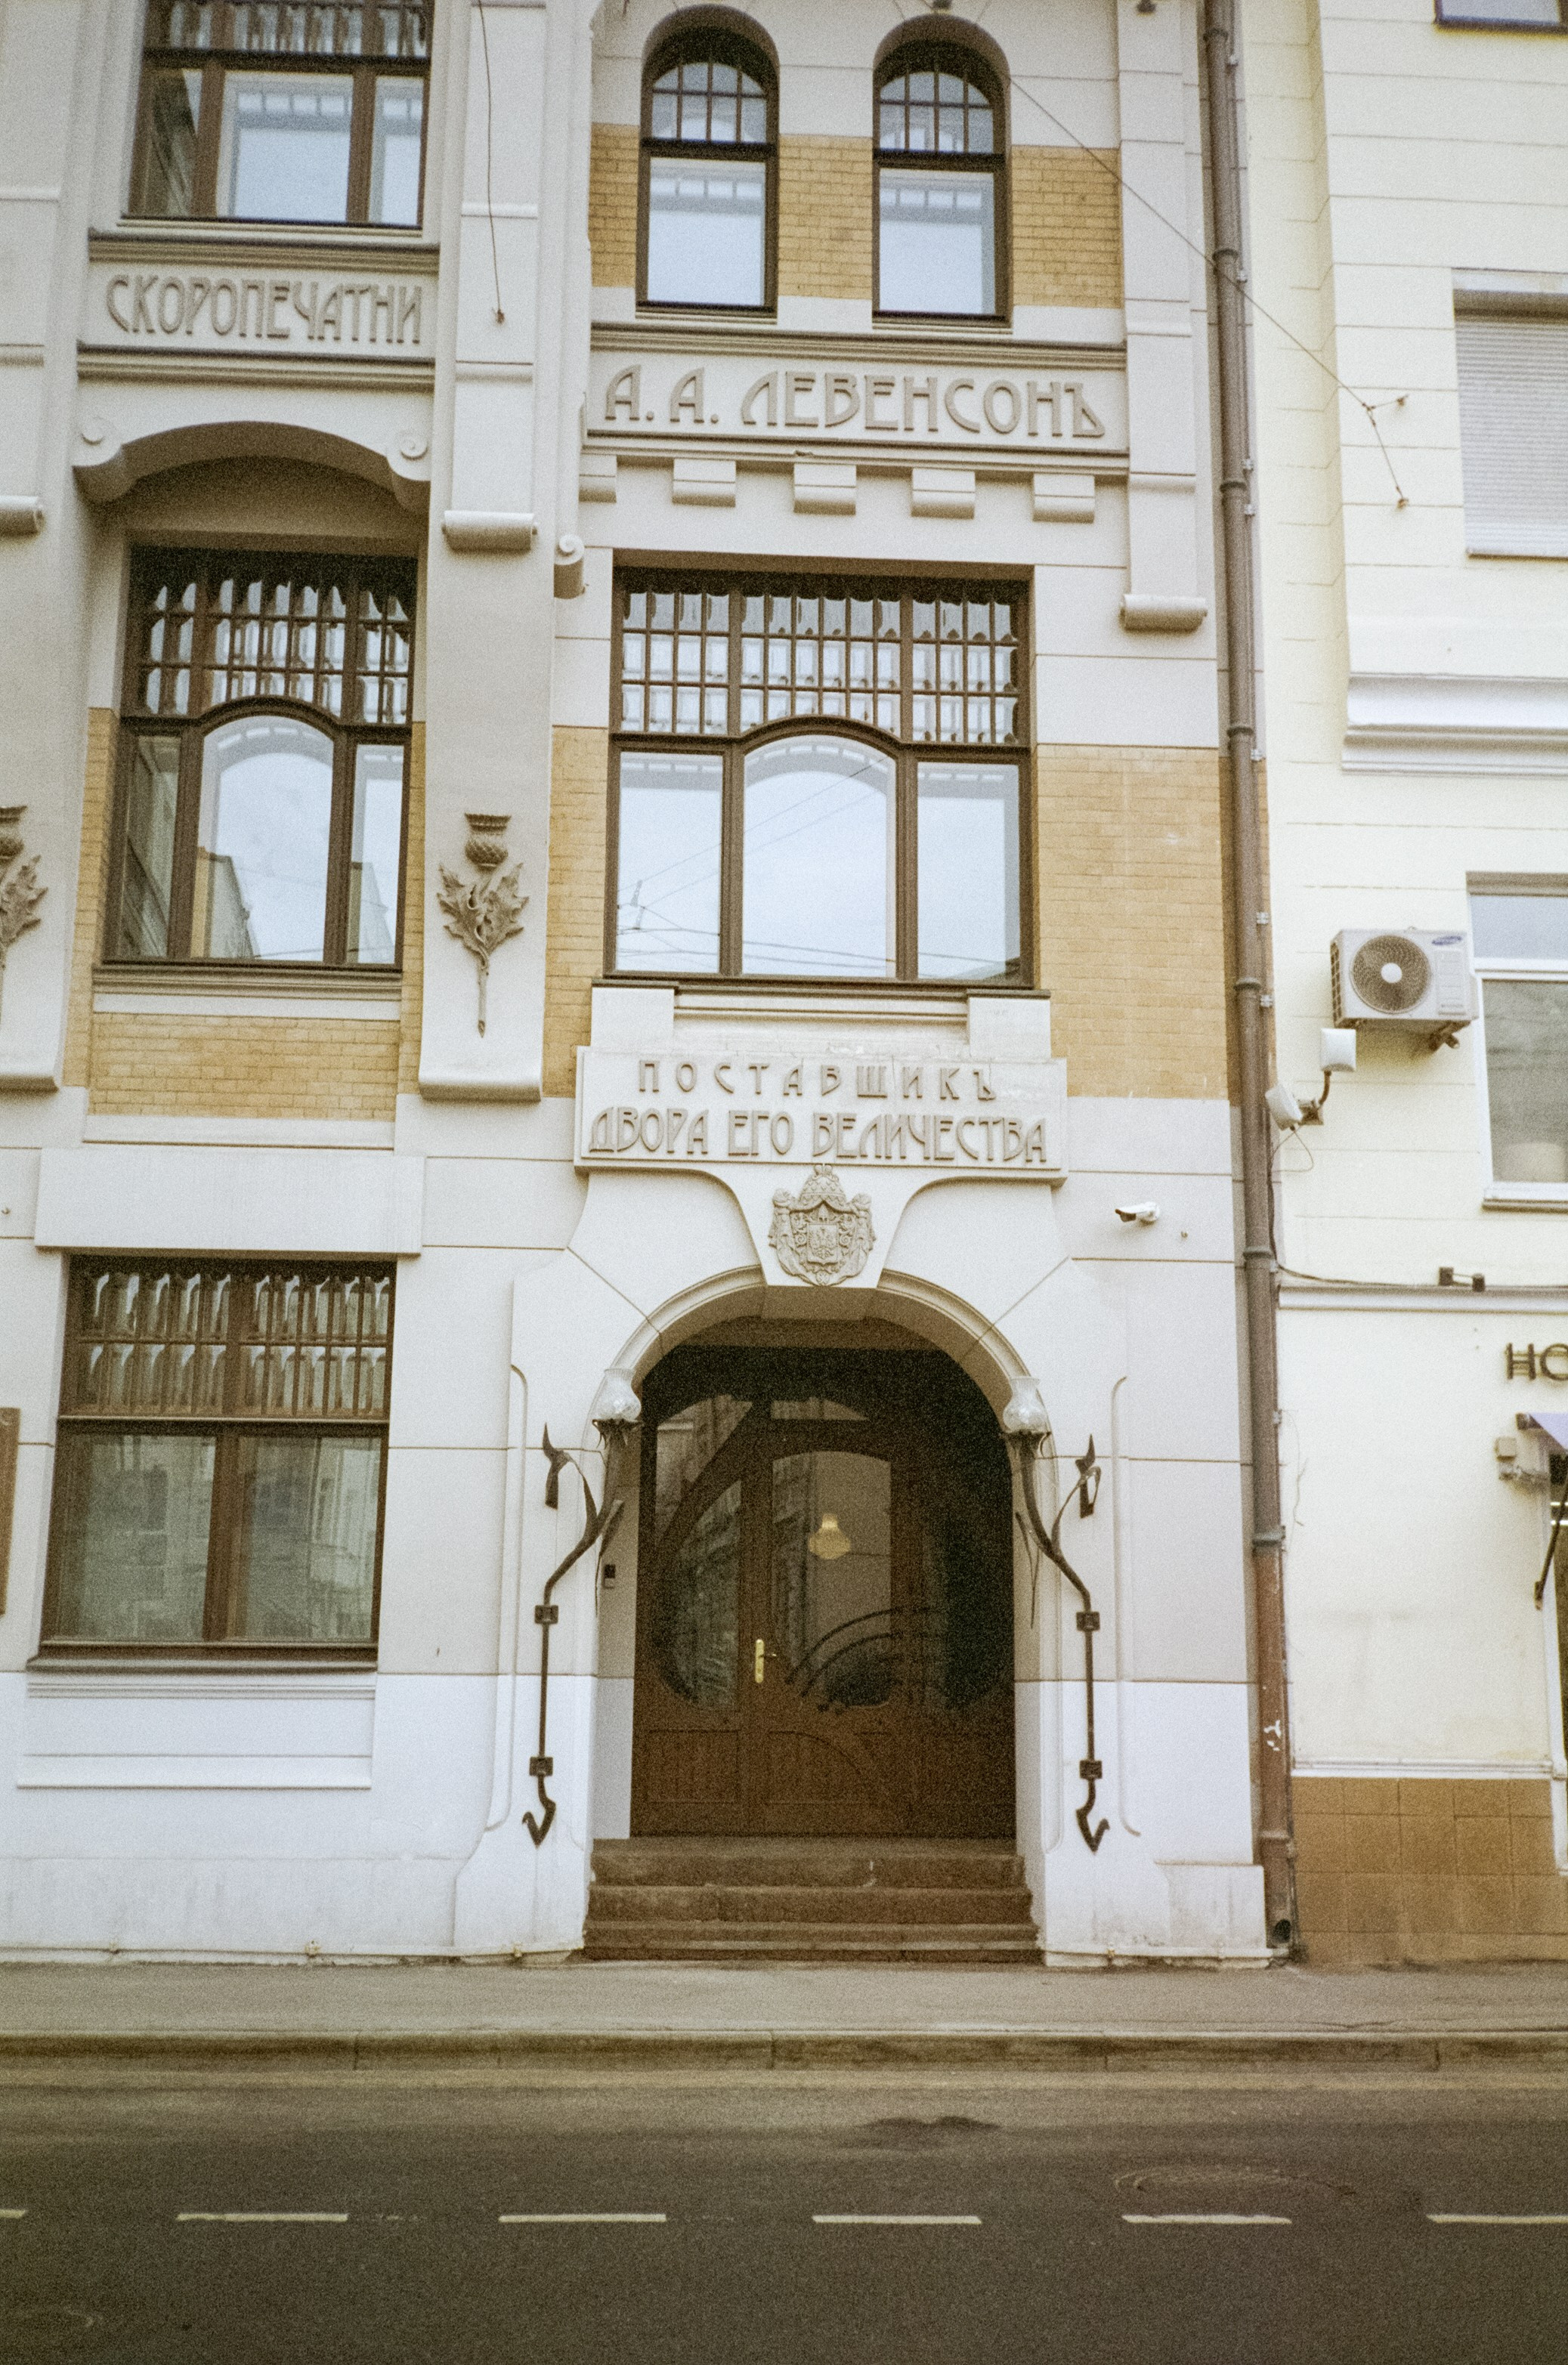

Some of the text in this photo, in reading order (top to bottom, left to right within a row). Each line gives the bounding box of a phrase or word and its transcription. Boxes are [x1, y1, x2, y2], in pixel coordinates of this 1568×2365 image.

[107, 274, 422, 344] СКОРОПЕЧАТНИ
[605, 365, 1106, 438] А. А. ЛЕВЕНСОНЪ
[589, 1107, 1047, 1162] ДВОРА ЕГО ВЕЛИЧЕСТВА
